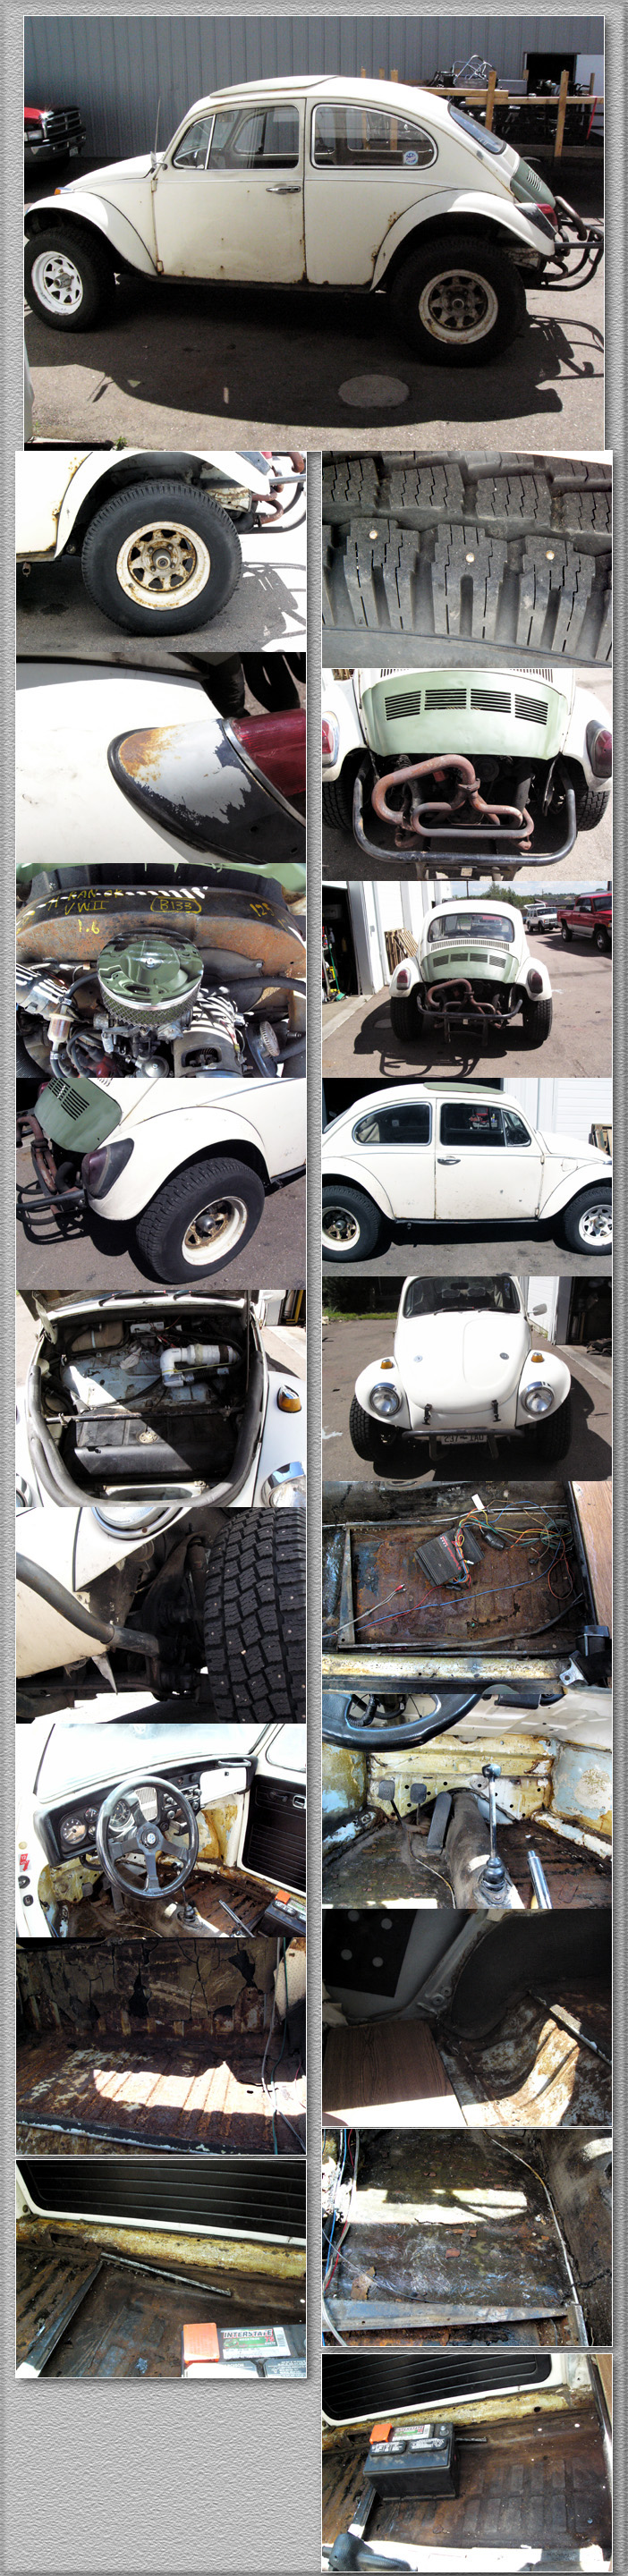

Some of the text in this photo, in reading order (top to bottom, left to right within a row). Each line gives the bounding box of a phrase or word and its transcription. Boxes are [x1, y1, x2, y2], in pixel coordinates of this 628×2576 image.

[159, 899, 193, 911] B133
[78, 919, 100, 935] 1.6
[224, 2330, 273, 2338] INTERSTATE
